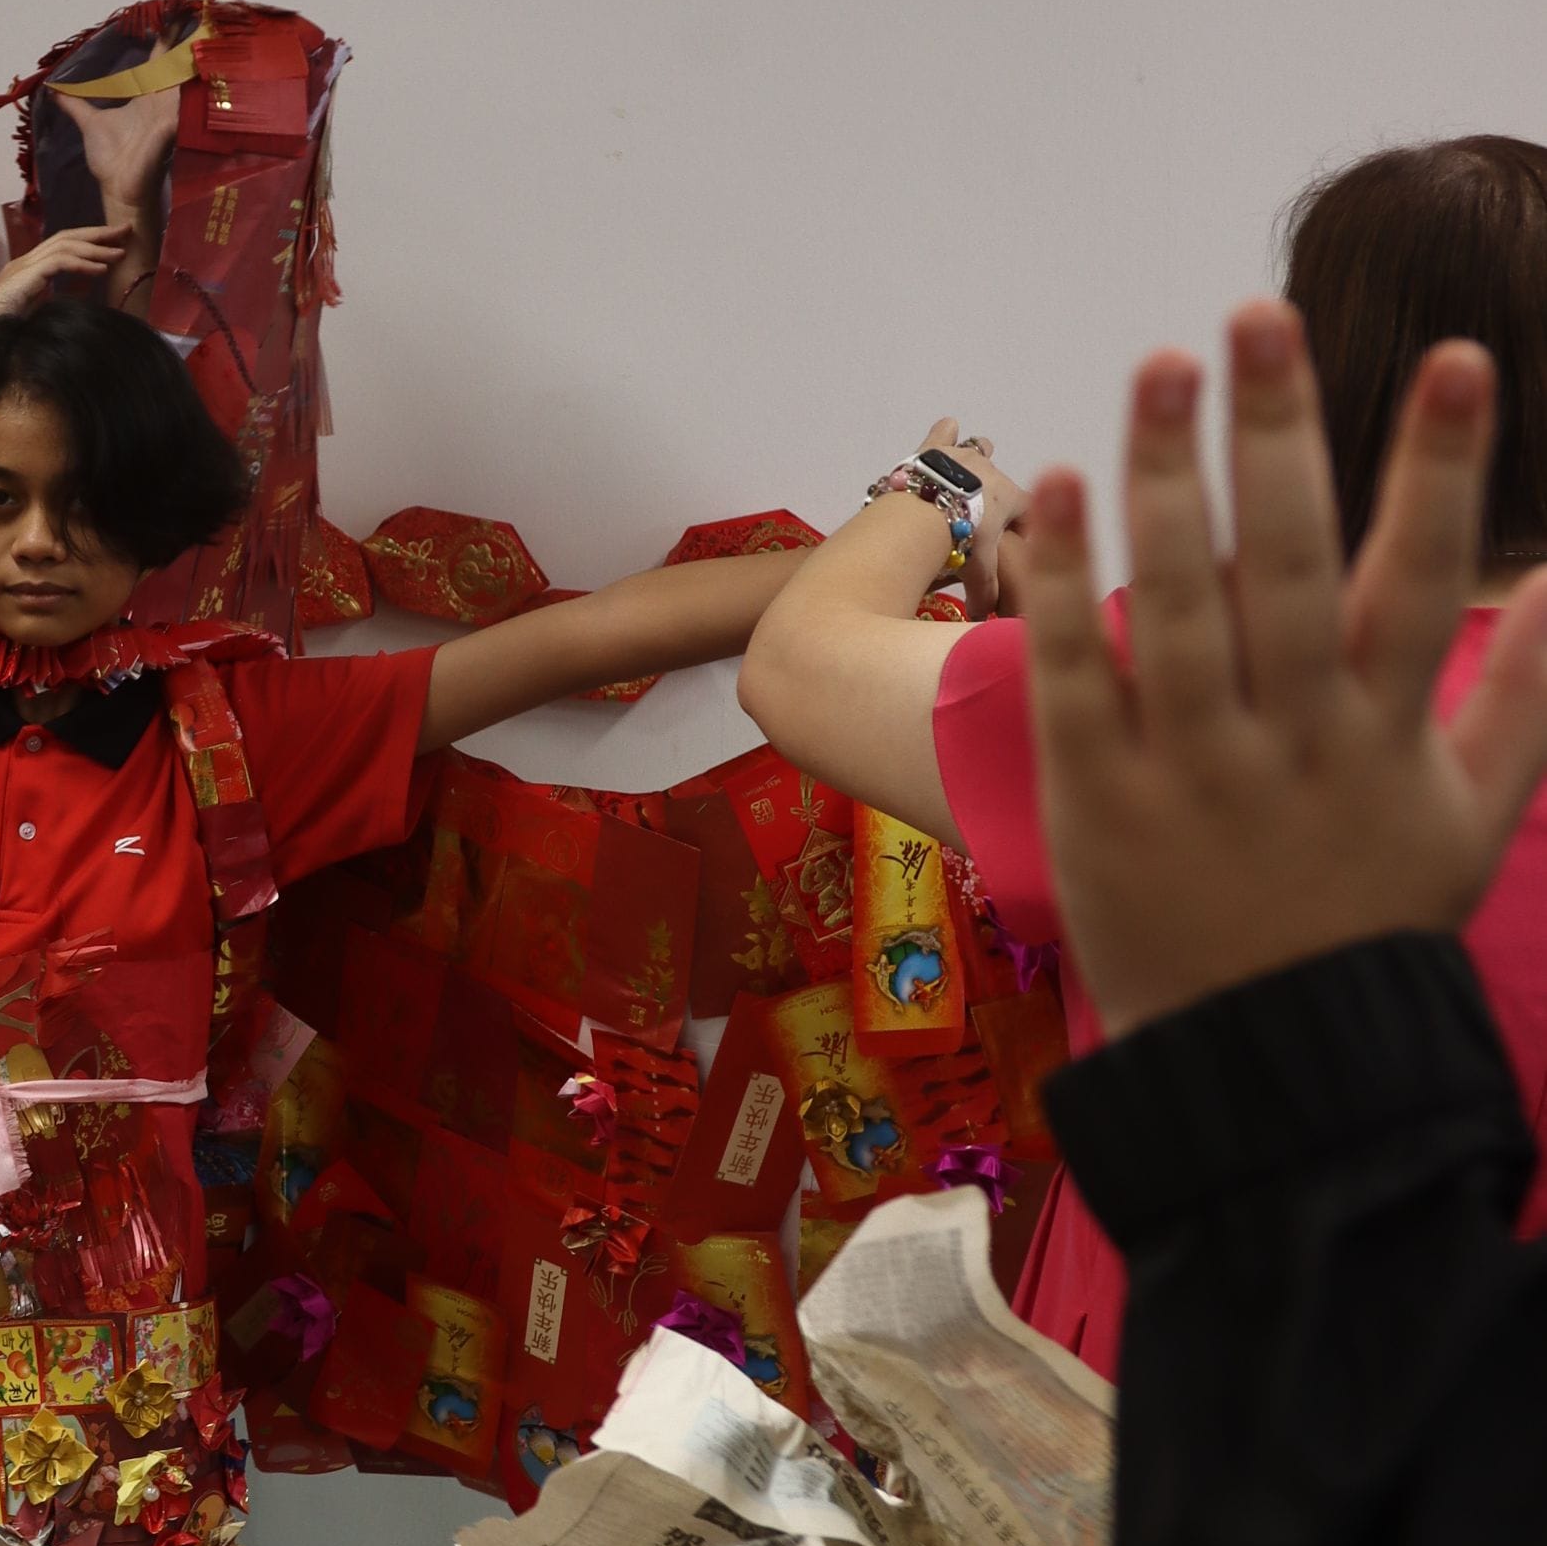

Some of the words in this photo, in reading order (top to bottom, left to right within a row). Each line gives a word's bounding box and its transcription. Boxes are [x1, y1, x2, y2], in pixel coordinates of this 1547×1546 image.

[722, 1075, 780, 1179] 新年快乐
[531, 1267, 560, 1354] 新年快乐
[1, 1328, 33, 1351] 大吉
[8, 1381, 38, 1403] 大利
